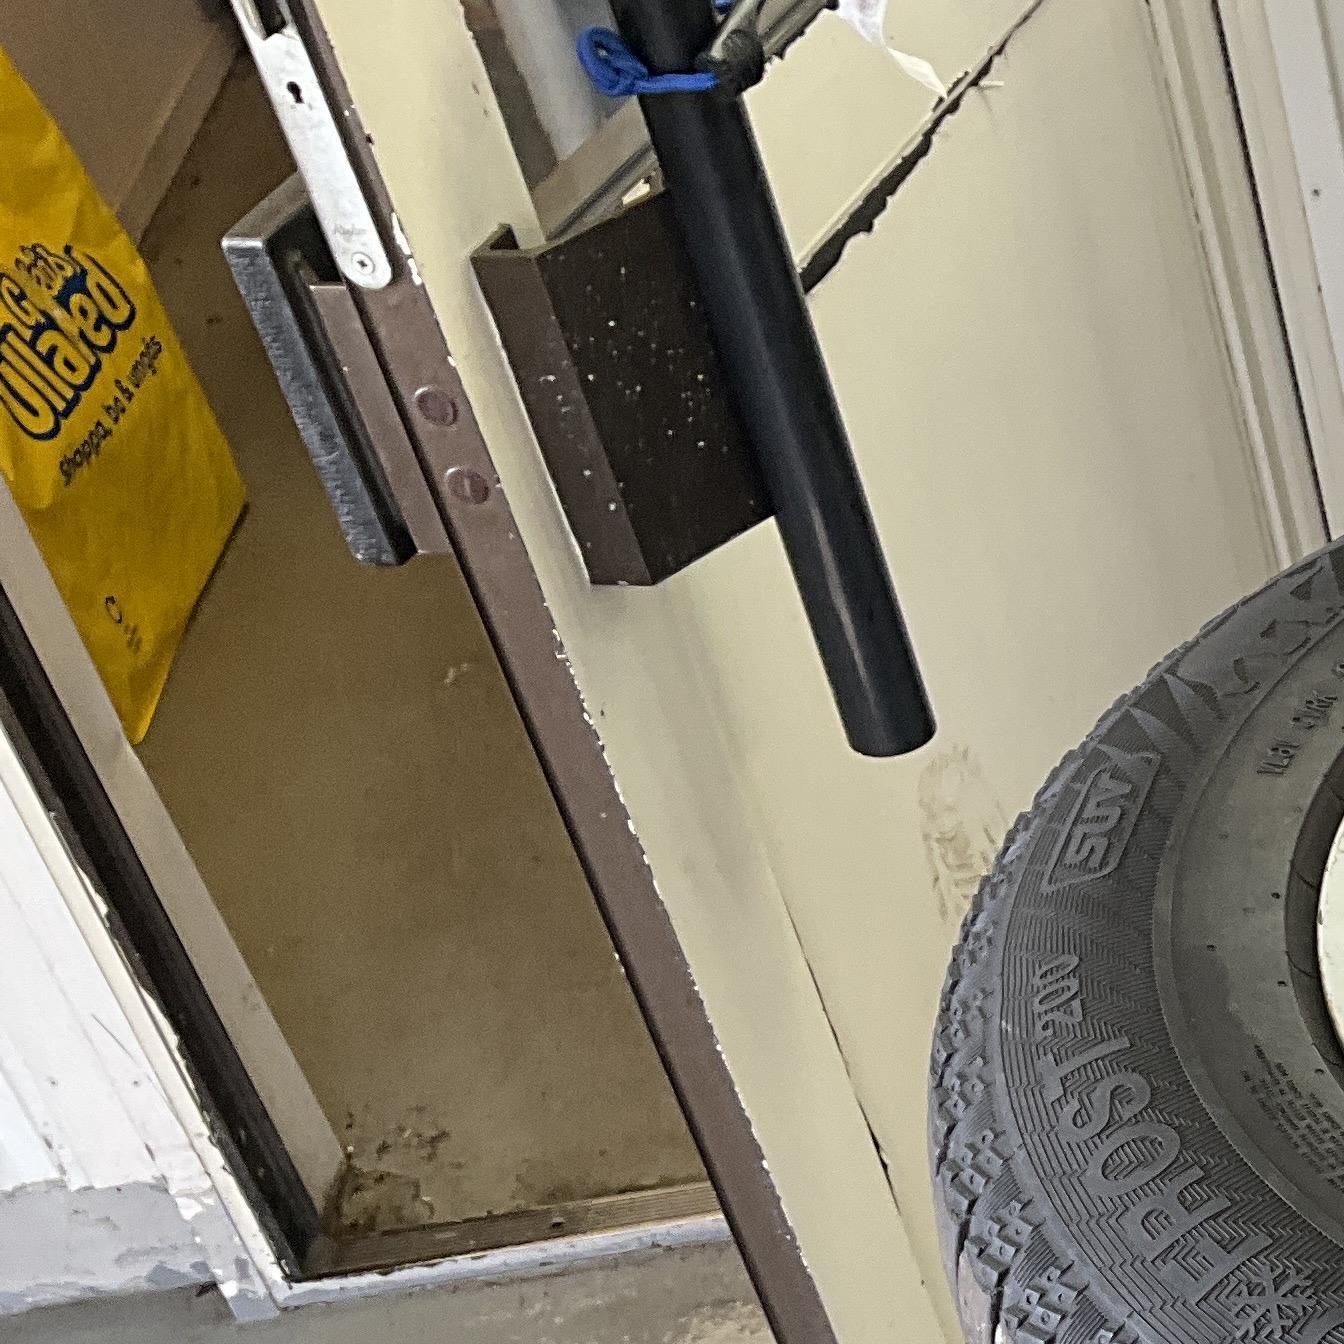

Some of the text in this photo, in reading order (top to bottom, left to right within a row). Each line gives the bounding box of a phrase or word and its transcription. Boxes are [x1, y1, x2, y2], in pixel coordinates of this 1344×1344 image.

[1063, 774, 1132, 872] SUV
[1033, 953, 1086, 1039] 200
[1037, 1034, 1270, 1295] FROST
